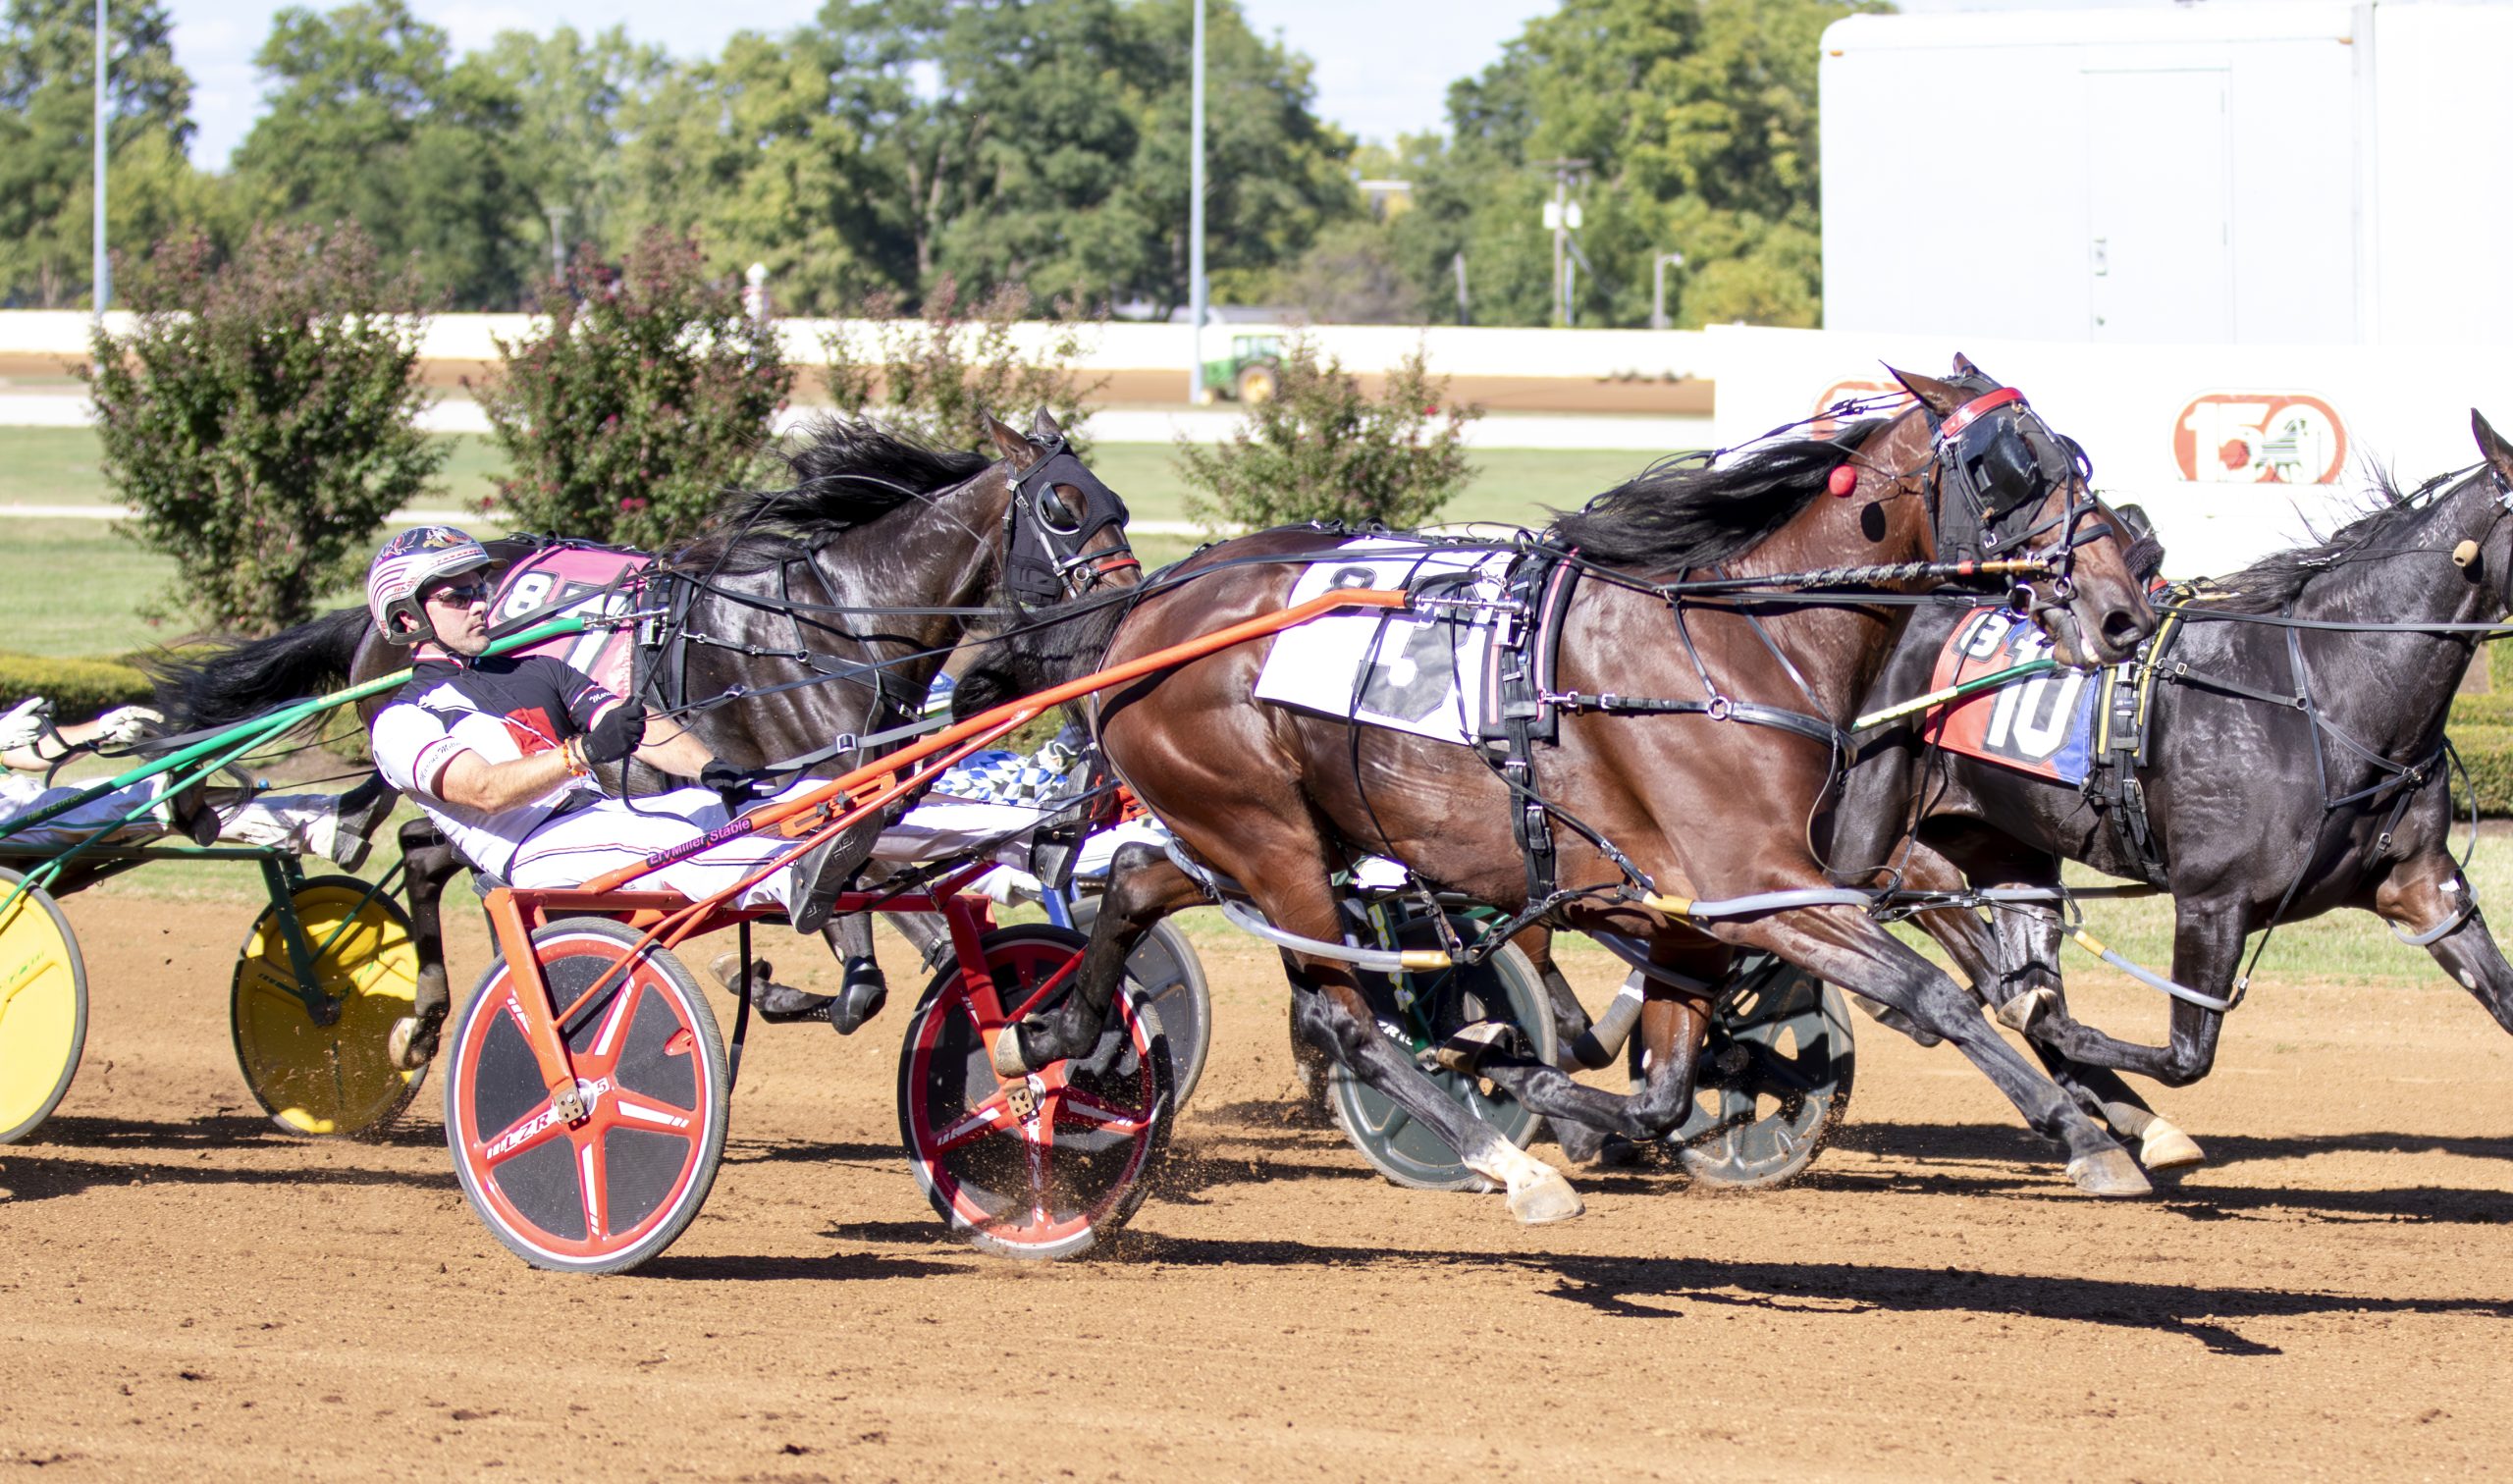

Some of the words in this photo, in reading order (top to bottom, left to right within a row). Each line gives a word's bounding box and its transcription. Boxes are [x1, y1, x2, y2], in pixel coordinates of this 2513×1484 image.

[2183, 402, 2337, 484] 150
[504, 573, 554, 618] 8
[1987, 629, 2086, 759] 10
[709, 819, 750, 842] Stable
[597, 1081, 607, 1092] 5
[505, 1113, 549, 1150] LZR
